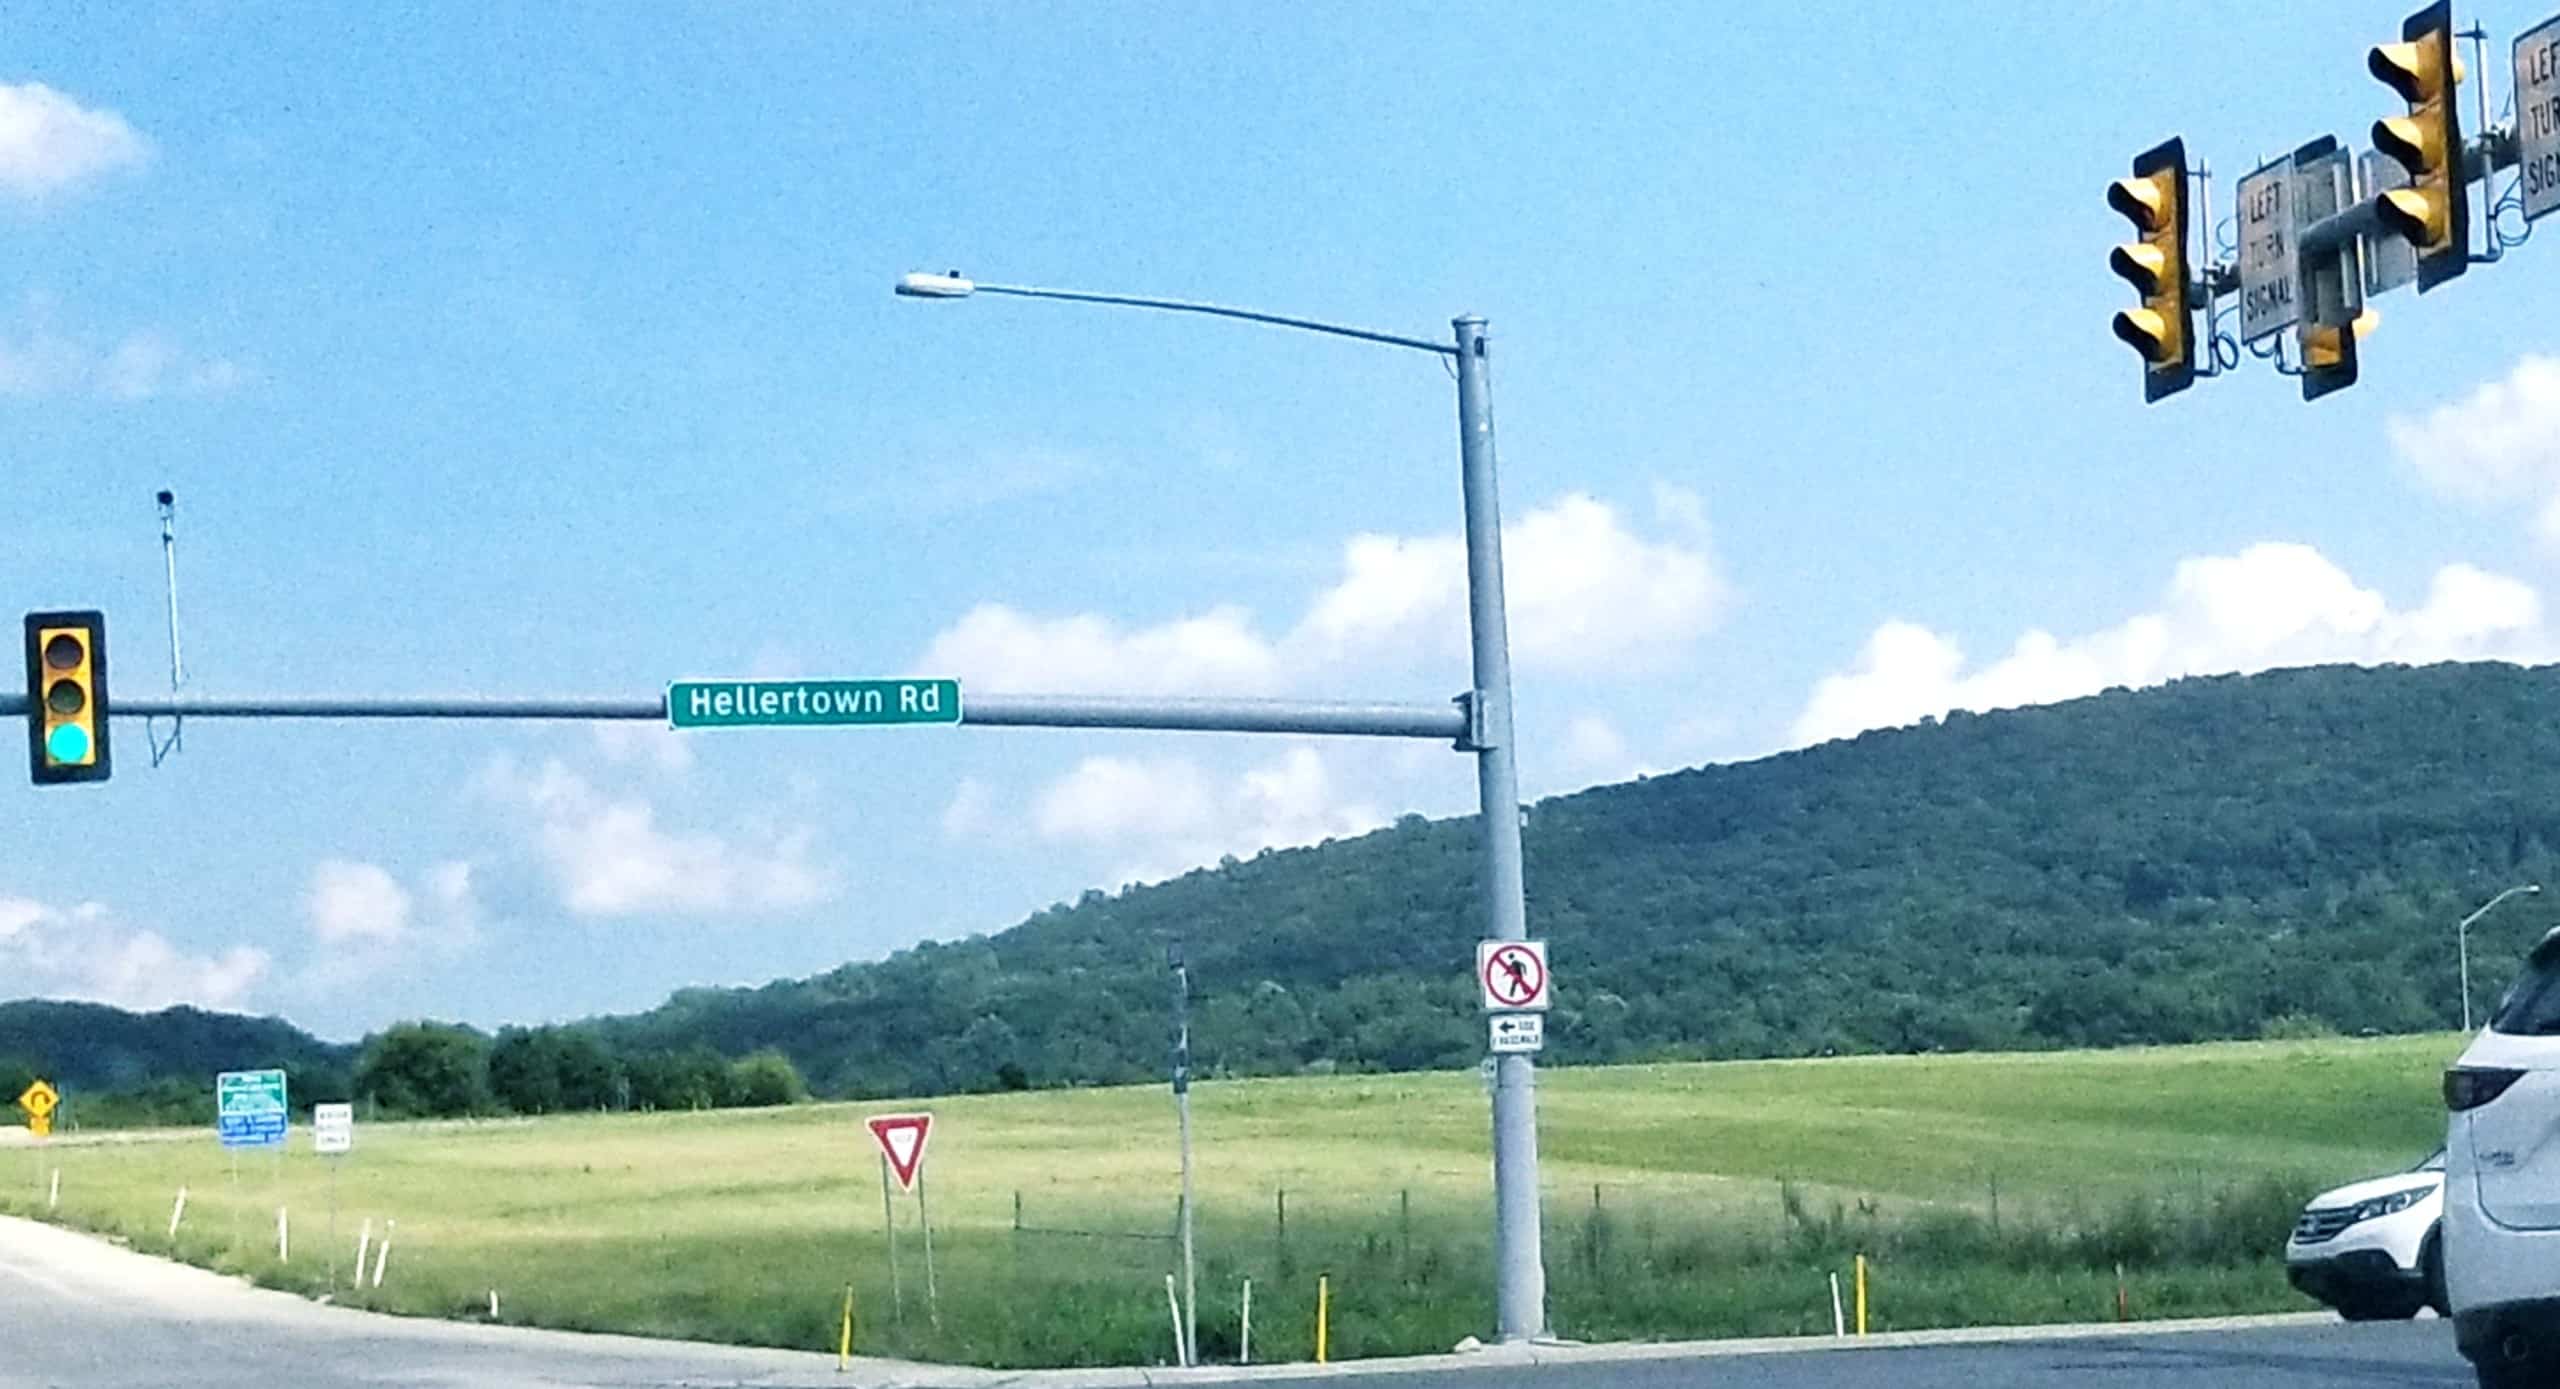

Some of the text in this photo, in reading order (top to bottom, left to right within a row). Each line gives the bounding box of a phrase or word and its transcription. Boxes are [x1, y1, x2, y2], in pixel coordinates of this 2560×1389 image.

[2529, 40, 2560, 85] LEF
[2530, 96, 2560, 140] TUR
[2249, 181, 2281, 224] LEFT
[2246, 275, 2292, 321] SIGNAL
[690, 683, 940, 716] Hellertown Rd
